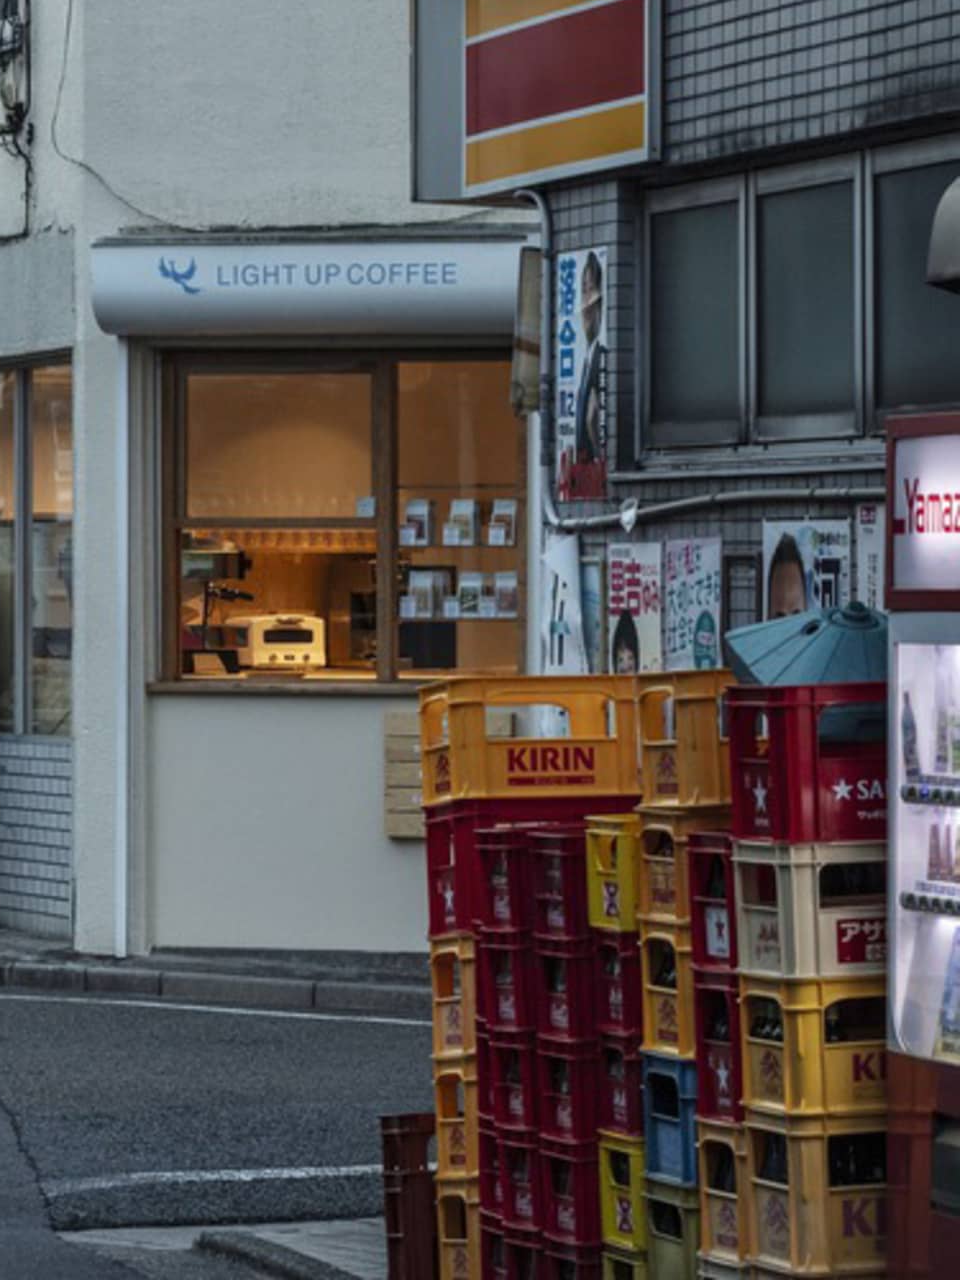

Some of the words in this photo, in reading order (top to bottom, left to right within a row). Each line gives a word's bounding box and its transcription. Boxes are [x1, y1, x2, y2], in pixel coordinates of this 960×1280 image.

[217, 263, 296, 286] LIGHT
[306, 263, 341, 286] UP
[347, 262, 457, 285] COFFEE
[507, 746, 595, 772] KIRIN
